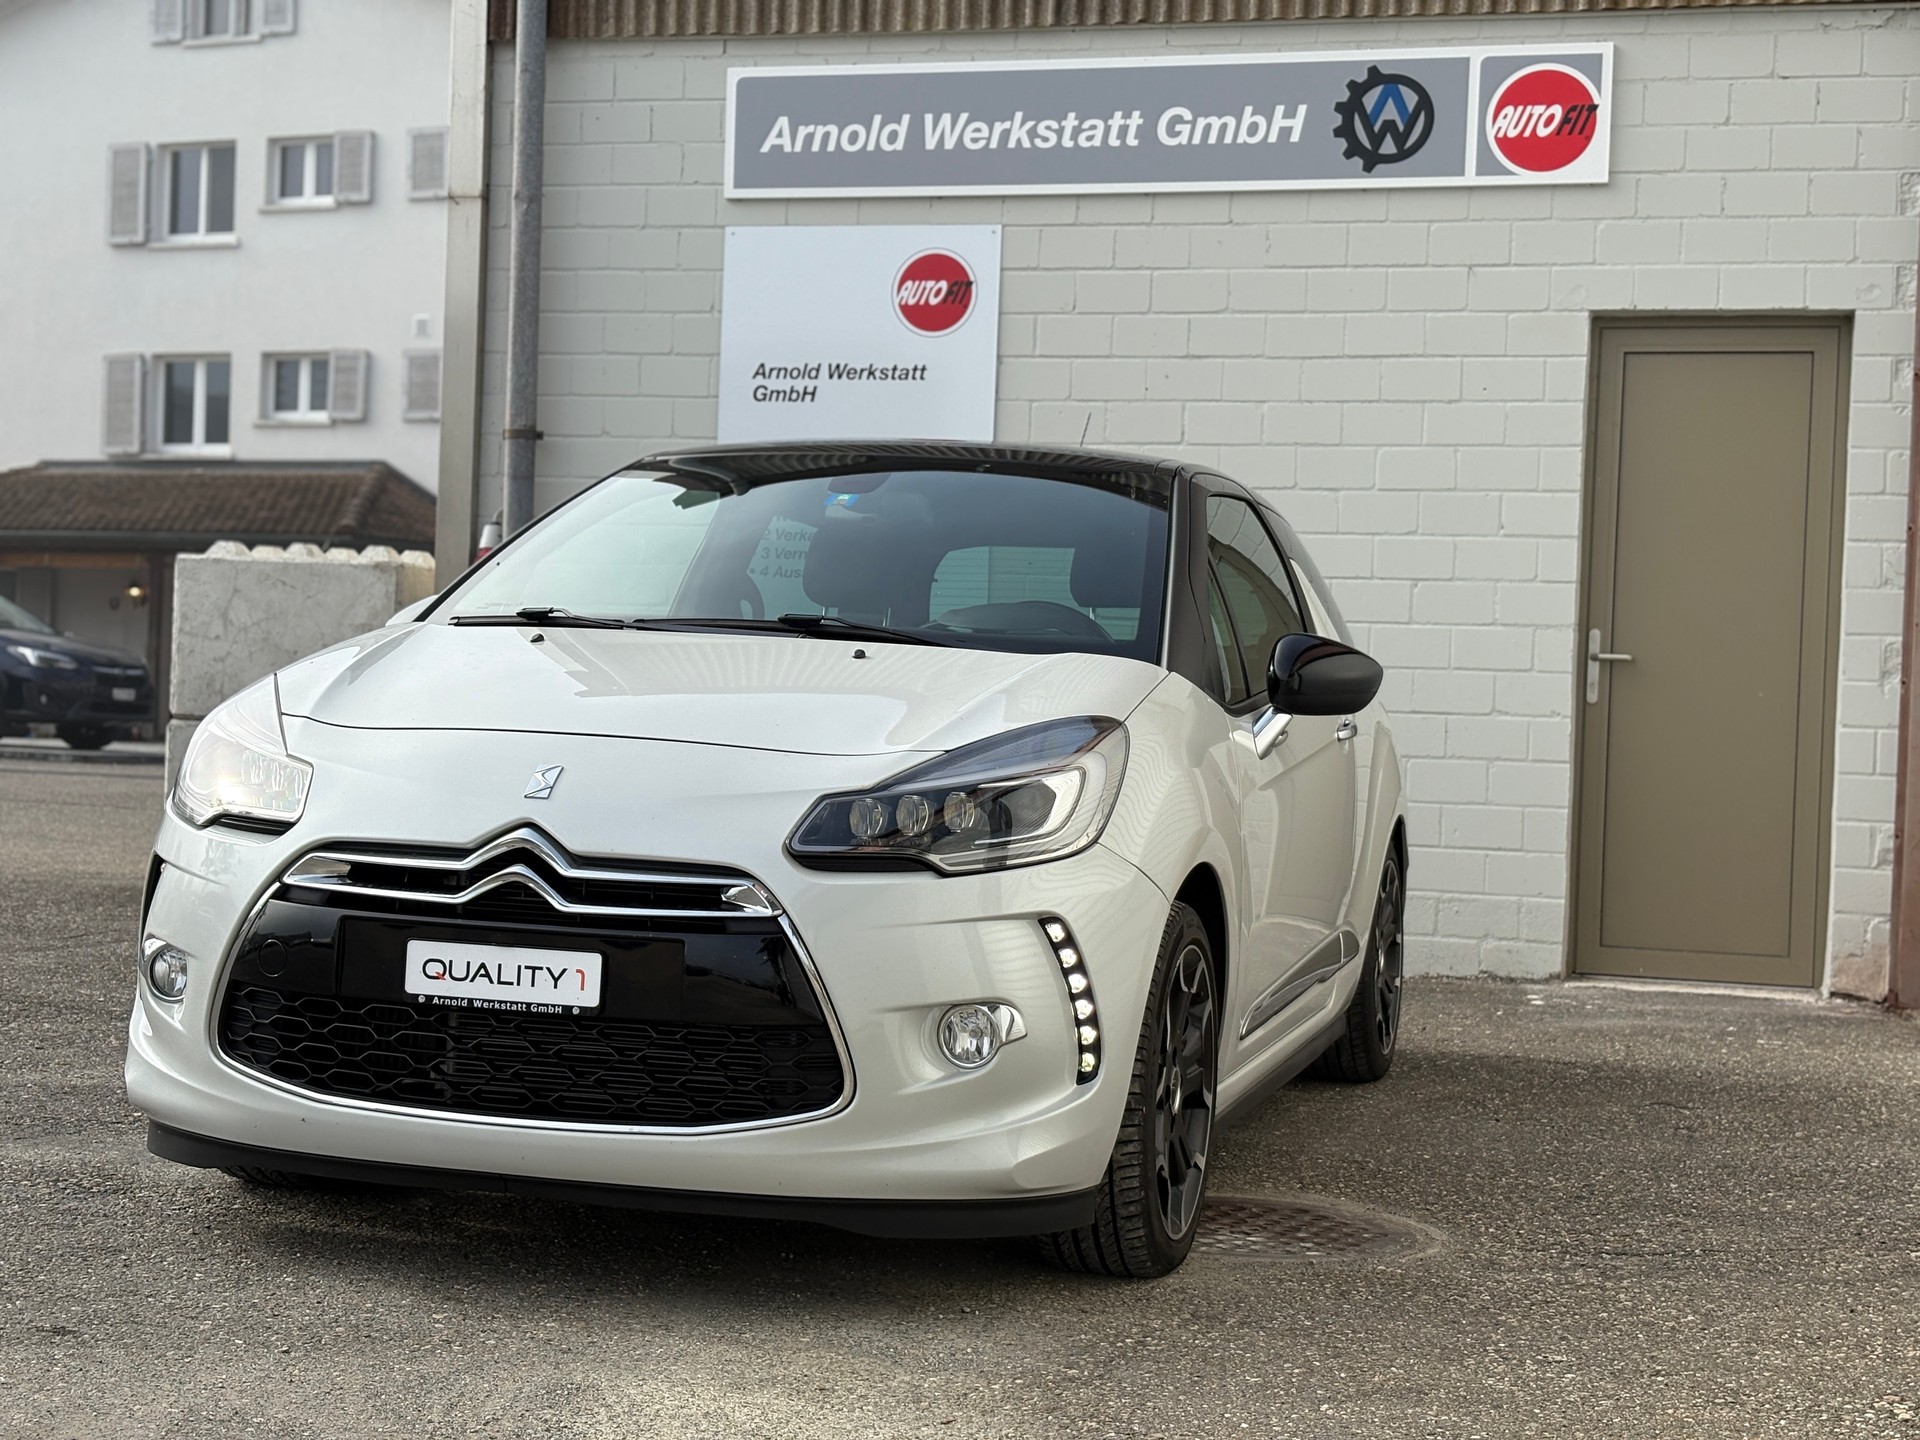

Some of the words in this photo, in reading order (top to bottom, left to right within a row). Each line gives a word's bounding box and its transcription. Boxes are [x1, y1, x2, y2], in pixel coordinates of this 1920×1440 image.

[759, 113, 911, 153] Arnold
[923, 111, 1144, 150] Werkstatt
[1156, 104, 1308, 146] GmbH
[1492, 103, 1600, 139] AUTOFIT
[897, 279, 974, 306] AUTOFIT
[752, 362, 821, 381] Arnold
[827, 362, 928, 382] Werkstatt
[752, 384, 817, 403] GmbH
[760, 547, 770, 560] 3
[759, 565, 769, 578] 4
[772, 565, 802, 578] Aus
[422, 958, 568, 989] QUALITY
[432, 996, 468, 1007] Arnold
[473, 999, 527, 1012] Werkstatt
[530, 1003, 563, 1014] GmbH
